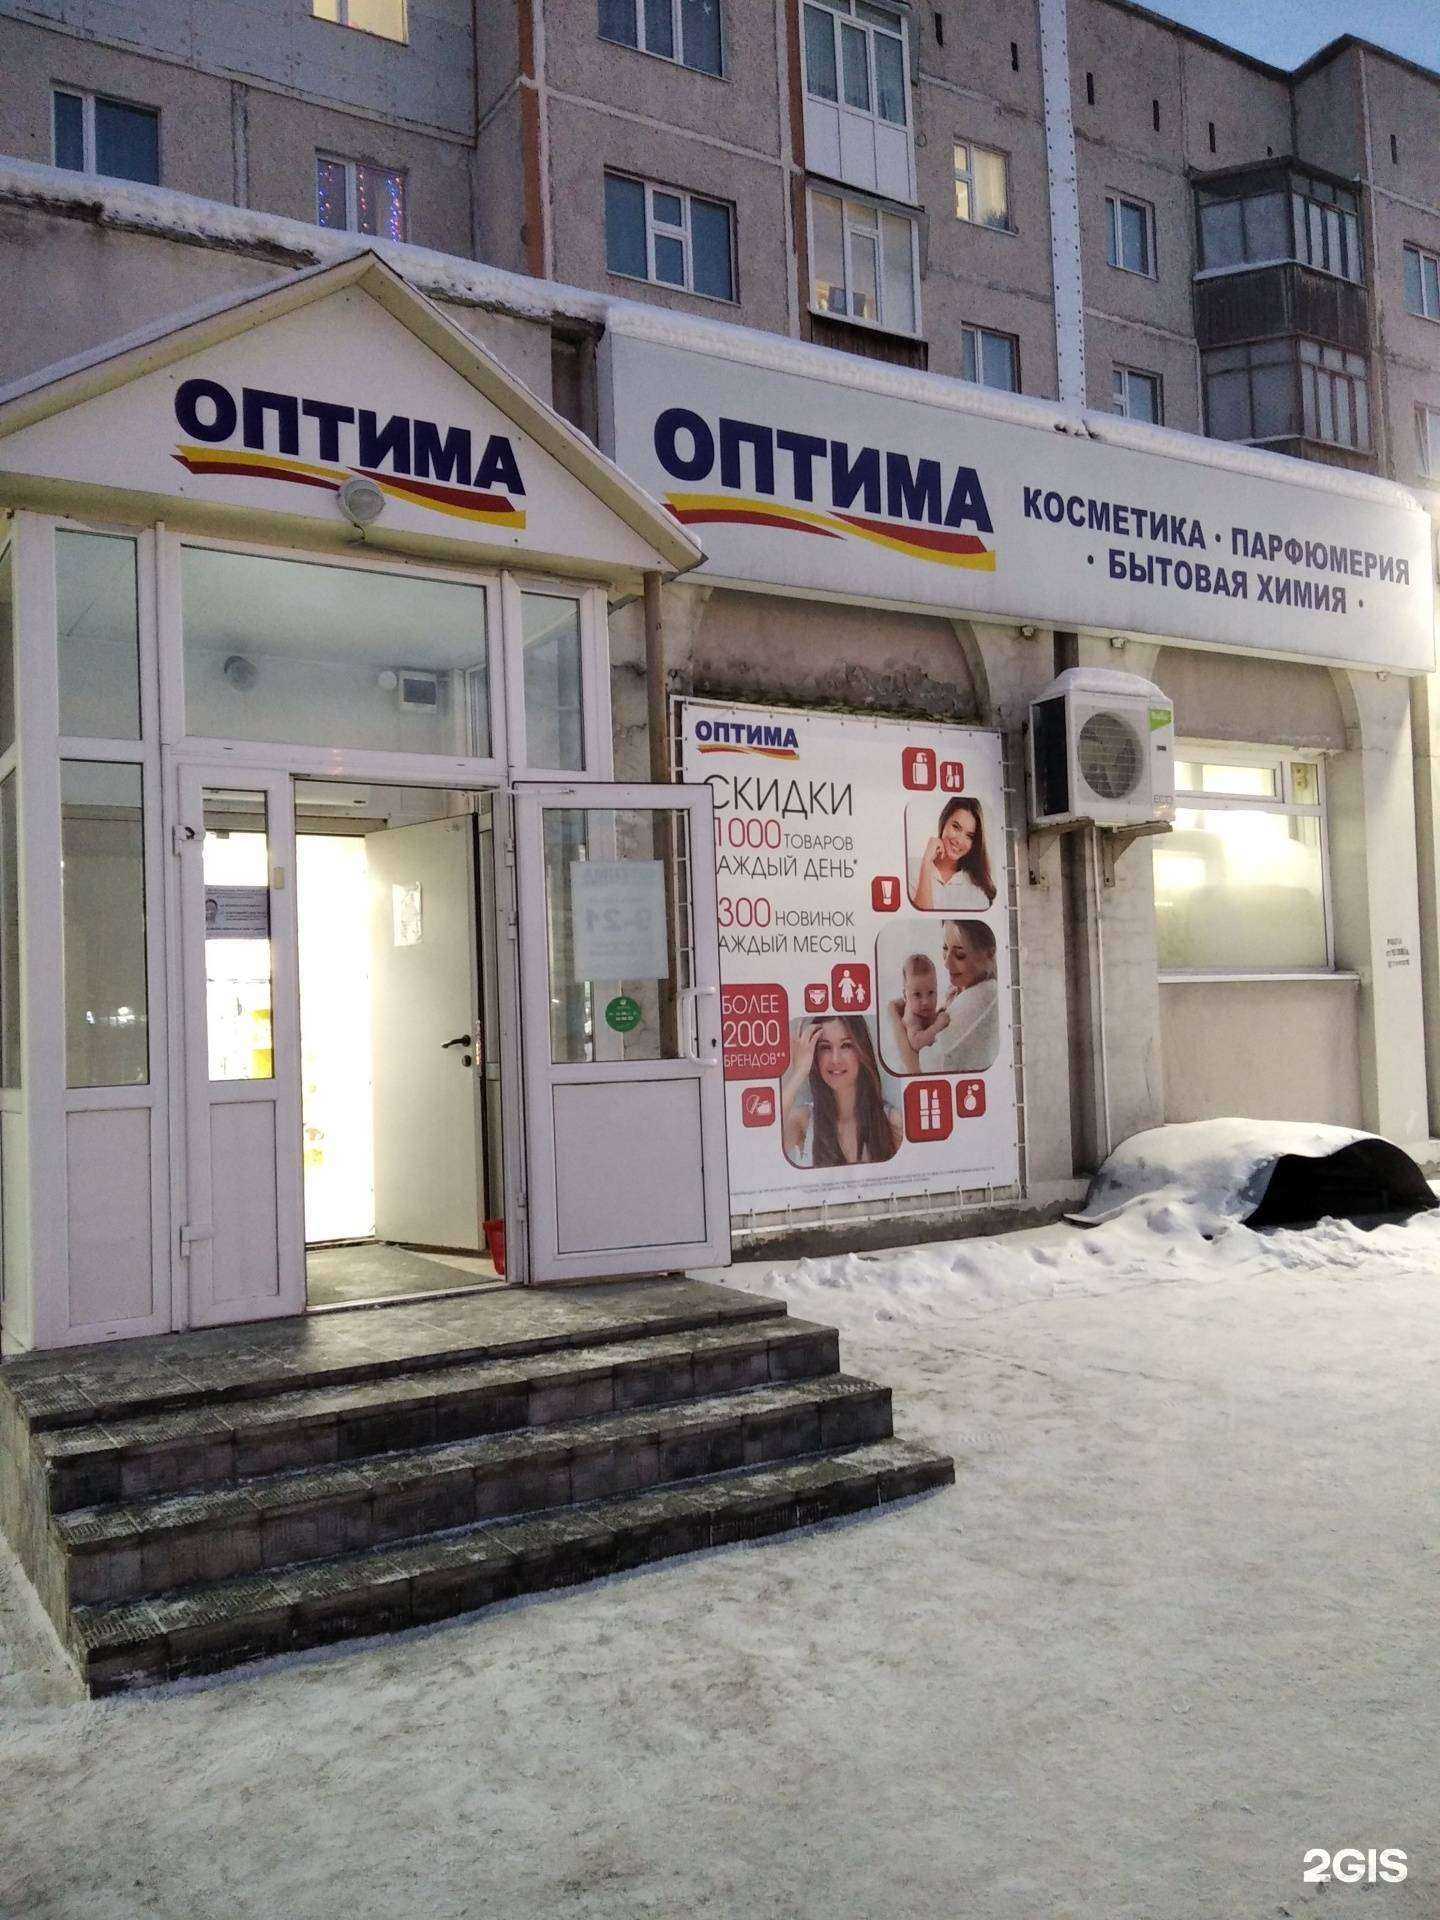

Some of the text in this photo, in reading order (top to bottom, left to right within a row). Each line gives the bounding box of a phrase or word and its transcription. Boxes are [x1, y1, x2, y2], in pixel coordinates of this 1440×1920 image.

[174, 378, 526, 496] ОПТИМА
[653, 407, 994, 533] ОПТИМА
[1023, 486, 1410, 585] КОСМЕТИКА ПАРФЮМЕРИЯ
[1108, 548, 1347, 614] БЫТОВАЯ ХИМИЯ
[695, 720, 799, 748] ОПТИМА
[704, 774, 852, 820] СКИДКИ
[714, 816, 854, 850] 1000 ТОВАРОВ
[716, 854, 797, 880] АЖДЫЙ
[718, 897, 856, 927] 300 НОВИНОК
[717, 933, 857, 956] АЖДЫЙ МЕСЯЦ
[722, 994, 779, 1015] БОЛЕЕ
[723, 1019, 781, 1048] 2000
